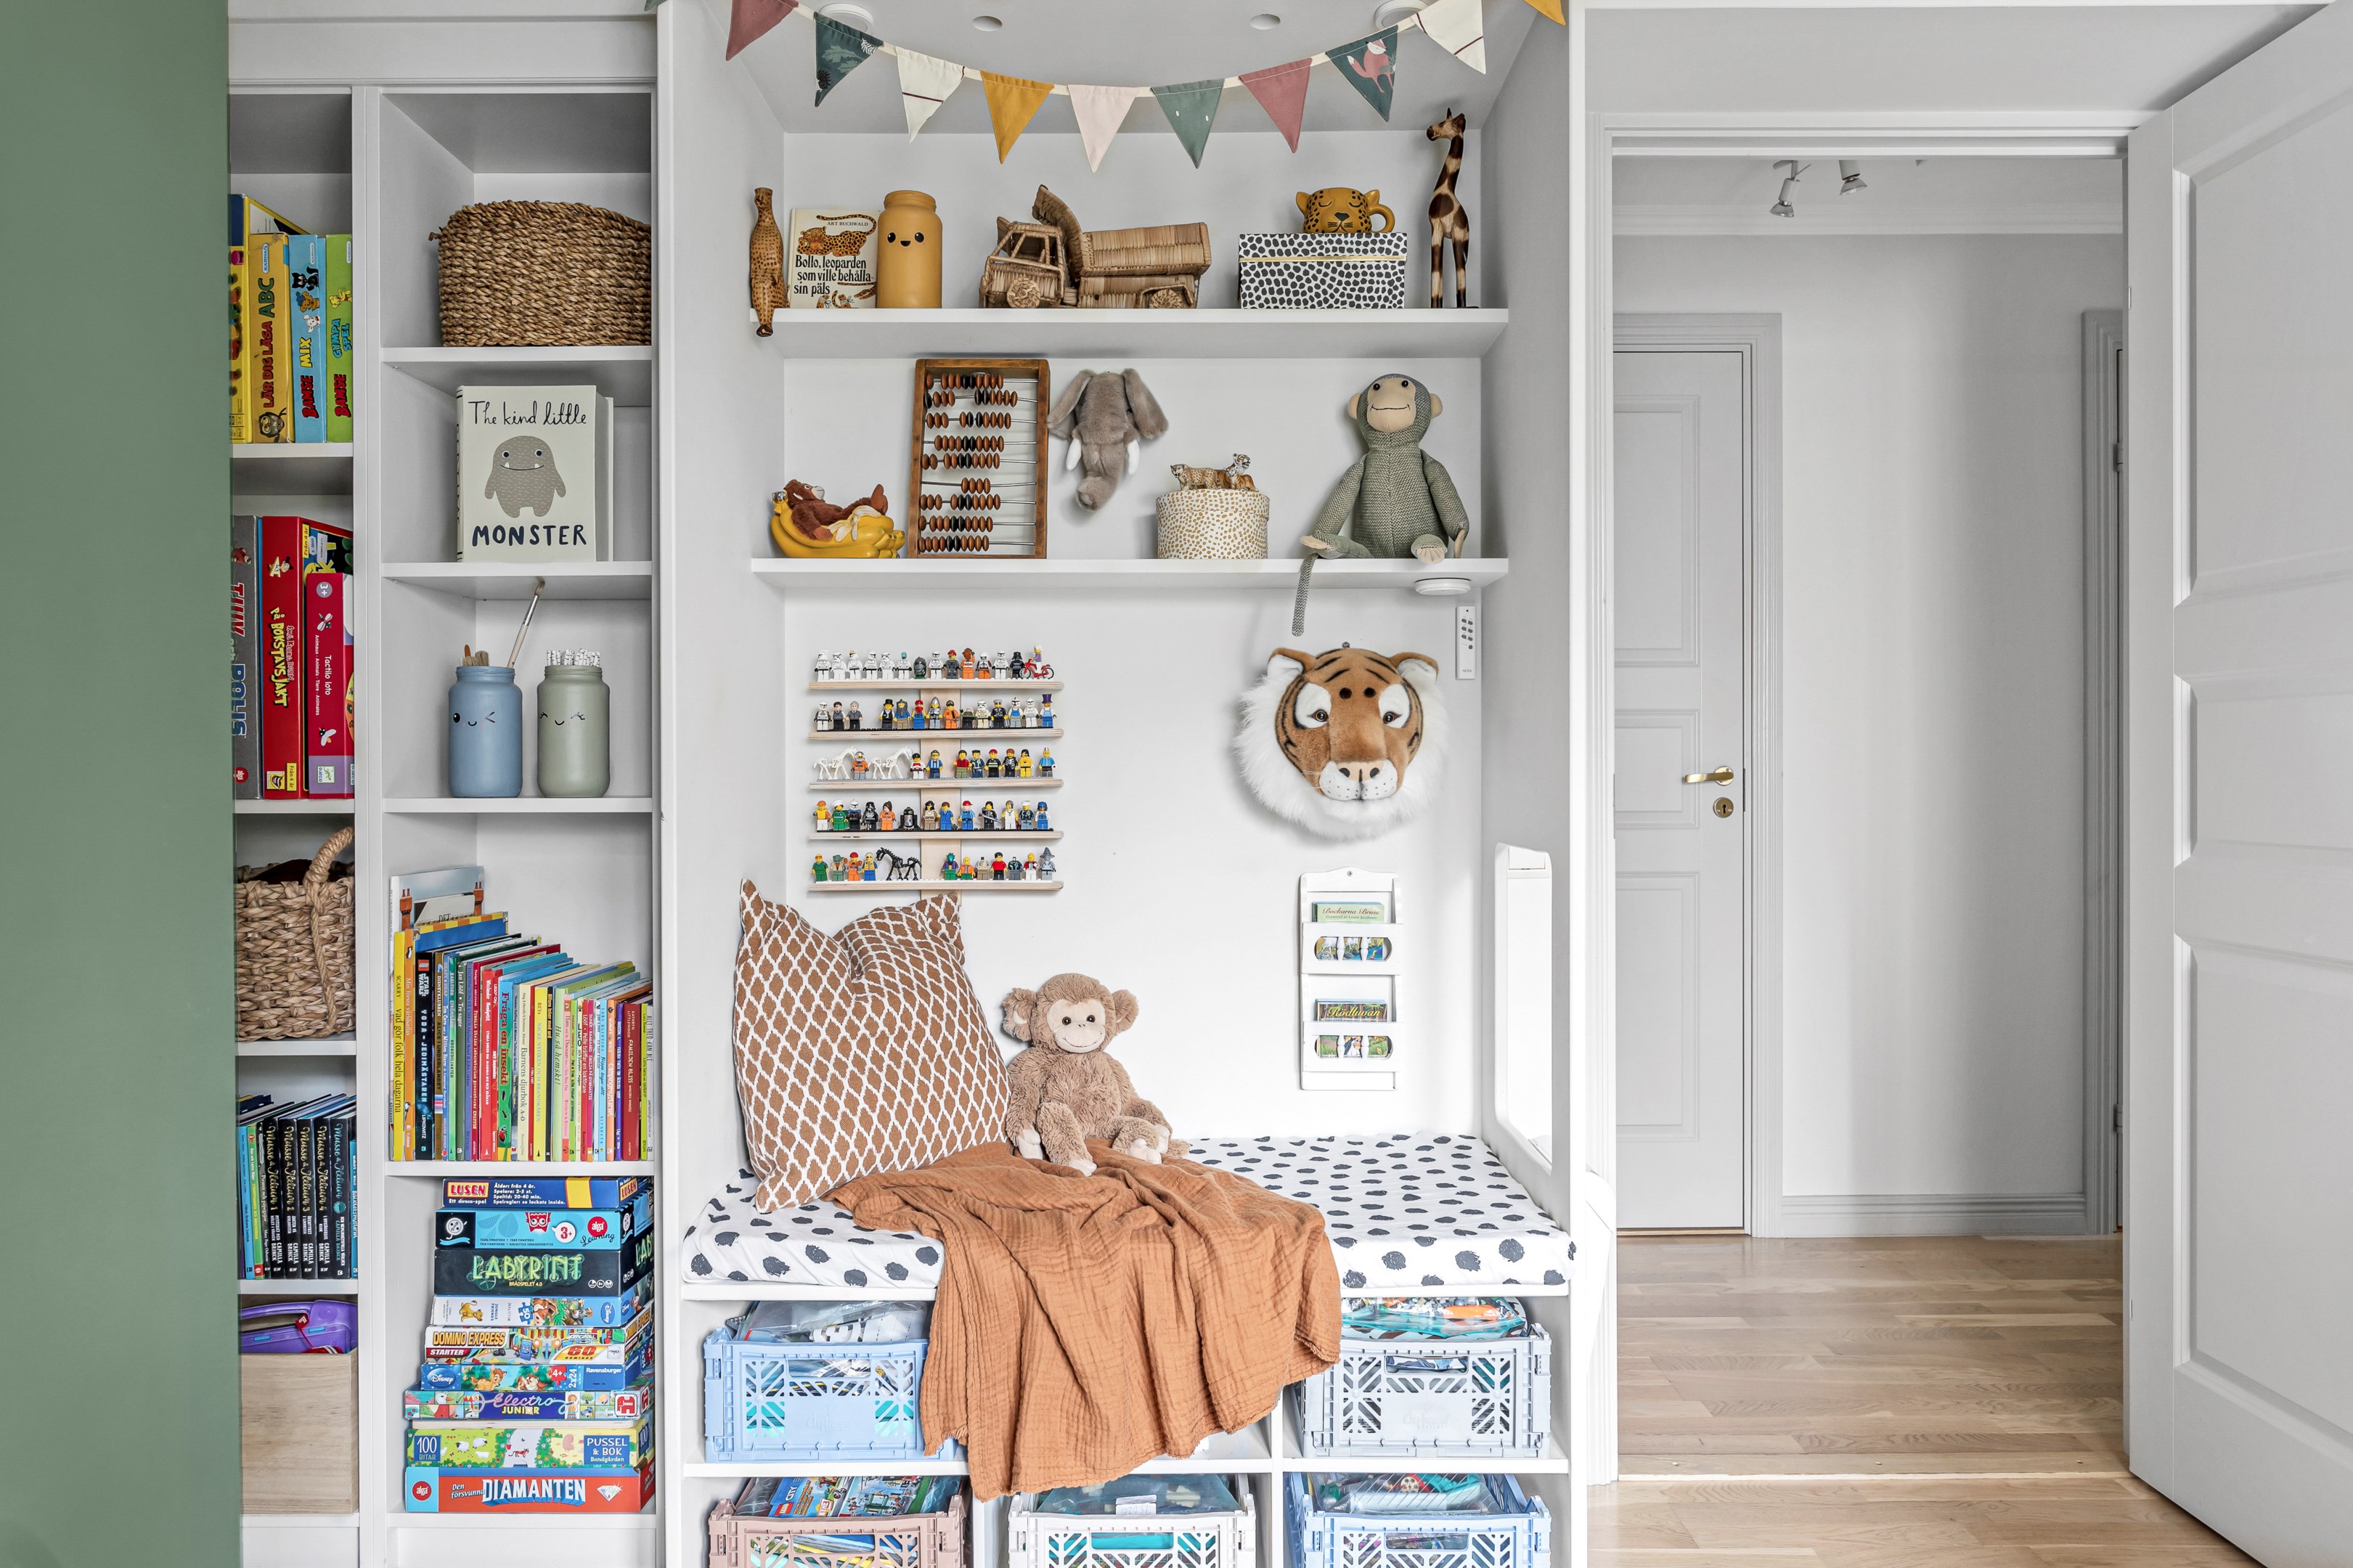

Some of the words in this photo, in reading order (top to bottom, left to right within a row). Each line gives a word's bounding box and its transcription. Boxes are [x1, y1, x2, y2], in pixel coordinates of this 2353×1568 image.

[795, 255, 821, 269] Bollo,
[823, 255, 866, 271] leoparden
[797, 271, 816, 281] som
[818, 269, 836, 282] ville
[839, 269, 871, 282] behålla
[258, 278, 274, 318] ABC
[794, 282, 808, 294] sin
[811, 282, 831, 297] päls
[259, 321, 273, 355] LÄSA
[331, 319, 342, 359] GYMPA
[340, 324, 352, 351] SPEL
[299, 337, 312, 367] MIX
[262, 359, 273, 380] DIG
[261, 382, 274, 408] LÄR
[301, 375, 319, 418] BAMSE
[333, 374, 351, 417] BAMSE
[468, 401, 497, 425] The
[503, 401, 537, 425] kind
[543, 401, 587, 425] little
[472, 524, 587, 547] MONSTER
[320, 584, 328, 596] 3+
[499, 992, 510, 1027] Fråga
[1327, 1005, 1382, 1018] Rödluvan
[501, 1031, 507, 1045] en
[395, 1042, 404, 1058] folk
[393, 1080, 403, 1113] dagarna
[266, 1126, 276, 1160] Musse
[284, 1127, 294, 1161] Musse
[301, 1127, 310, 1161] Musse
[317, 1126, 327, 1160] Musse
[334, 1124, 343, 1156] Musse
[267, 1167, 279, 1204] Helium
[285, 1168, 295, 1204] Helium
[301, 1168, 311, 1205] Helium
[317, 1167, 328, 1204] Helium
[334, 1162, 344, 1198] Helium
[621, 1181, 636, 1198] LUSEN
[451, 1185, 486, 1196] LUSEN
[560, 1226, 572, 1239] 3+
[592, 1222, 605, 1232] alga
[580, 1233, 615, 1247] Learning
[472, 1255, 583, 1281] LABYRINT
[523, 1307, 531, 1320] 50
[603, 1303, 612, 1323] Disney
[433, 1331, 467, 1346] DOMINO
[468, 1331, 505, 1346] EXPRESS
[568, 1346, 597, 1356] 60
[431, 1374, 453, 1384] Disney
[553, 1369, 563, 1378] 4+
[568, 1368, 577, 1388] 2x24
[494, 1392, 554, 1407] Electro
[417, 1438, 437, 1453] 100
[417, 1487, 428, 1495] alga
[451, 1489, 485, 1500] försvunna
[482, 1479, 586, 1505] DIAMANTEN
[786, 1486, 797, 1501] CITY
[780, 1503, 788, 1514] LEGO
